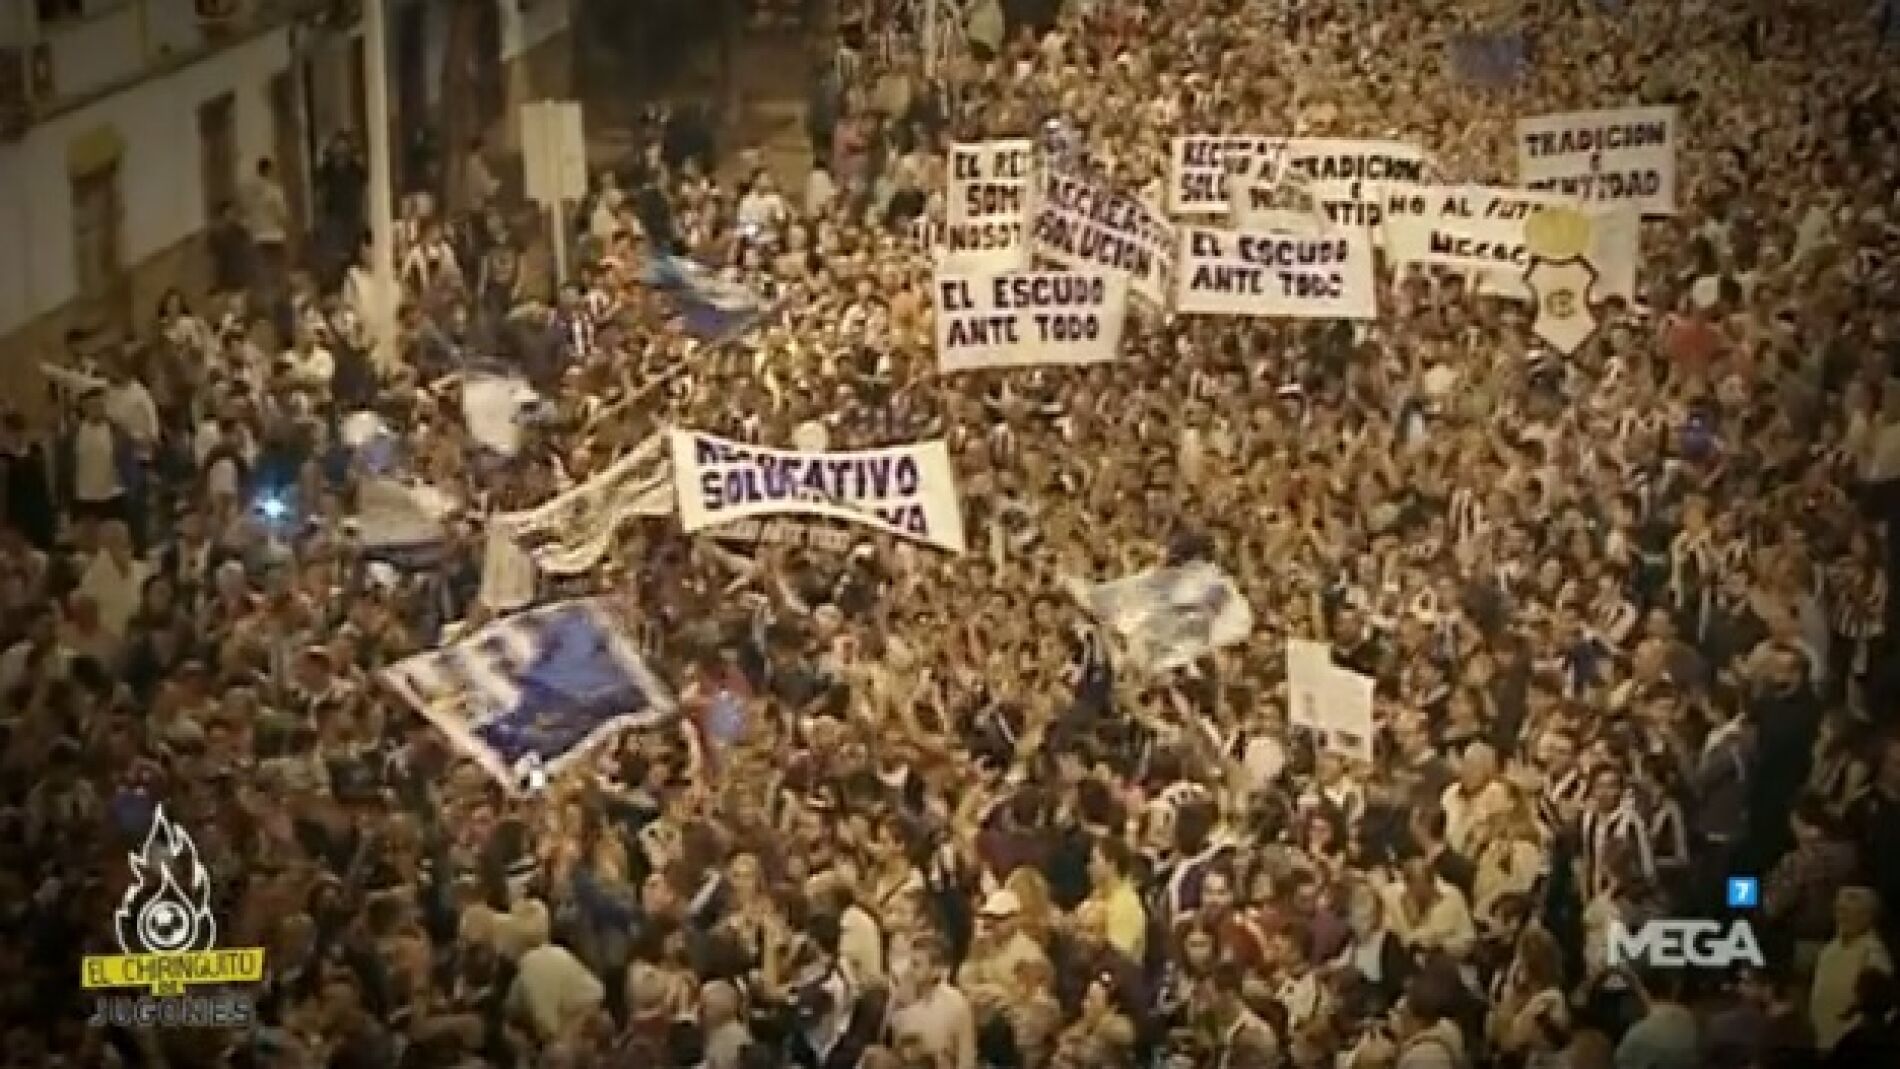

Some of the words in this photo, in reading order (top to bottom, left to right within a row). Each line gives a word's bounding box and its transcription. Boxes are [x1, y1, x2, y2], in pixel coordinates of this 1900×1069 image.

[1524, 121, 1666, 158] TRADICION
[1441, 196, 1474, 218] AL
[1191, 231, 1222, 257] EL
[1239, 235, 1348, 266] ESCUDO
[940, 281, 974, 311] EL
[993, 276, 1103, 308] ESCUDO
[1190, 265, 1264, 294] ANTE
[1277, 271, 1341, 298] TODO
[947, 316, 1020, 347] ANTE
[1034, 314, 1099, 342] TODO
